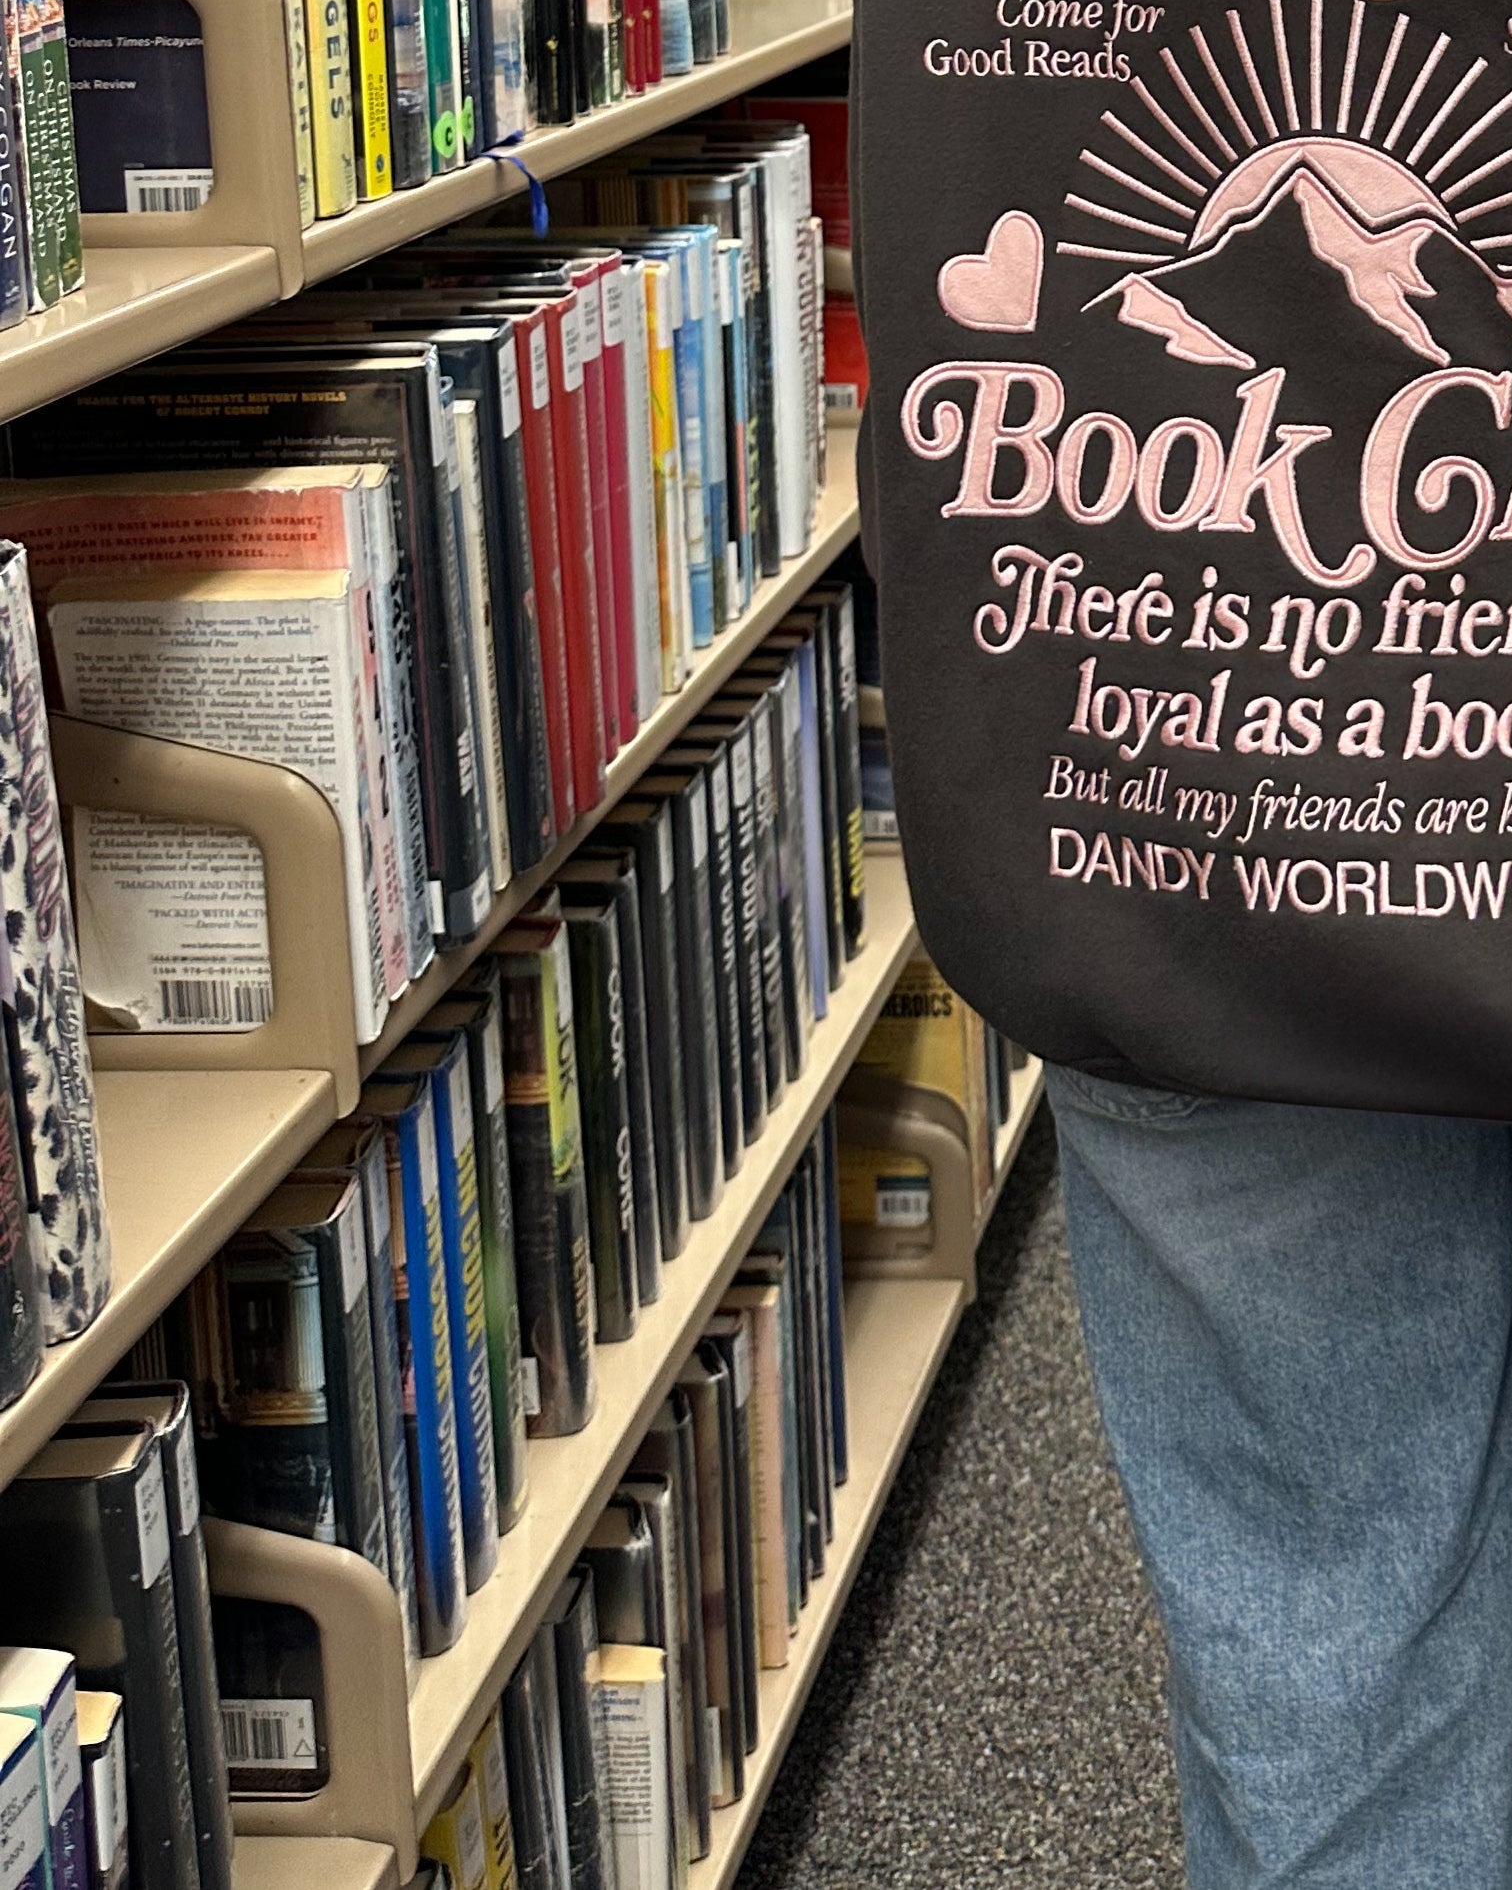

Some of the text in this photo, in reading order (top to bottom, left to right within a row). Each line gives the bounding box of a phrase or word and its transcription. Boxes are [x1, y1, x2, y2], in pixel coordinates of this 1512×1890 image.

[69, 36, 113, 49] Orleans
[922, 38, 1134, 84] Good Reads
[93, 78, 138, 91] Review
[901, 360, 1377, 589] Book
[973, 545, 1174, 657] There
[1189, 566, 1252, 651] is
[1260, 592, 1365, 679] no
[1068, 657, 1232, 761] loyal
[1235, 701, 1325, 758] as
[1336, 701, 1386, 761] a
[1043, 757, 1111, 804] But
[1119, 767, 1168, 818] all
[1175, 788, 1238, 840] my
[1235, 778, 1407, 845] friends
[1414, 795, 1489, 837] are
[1050, 828, 1215, 900] DANDY
